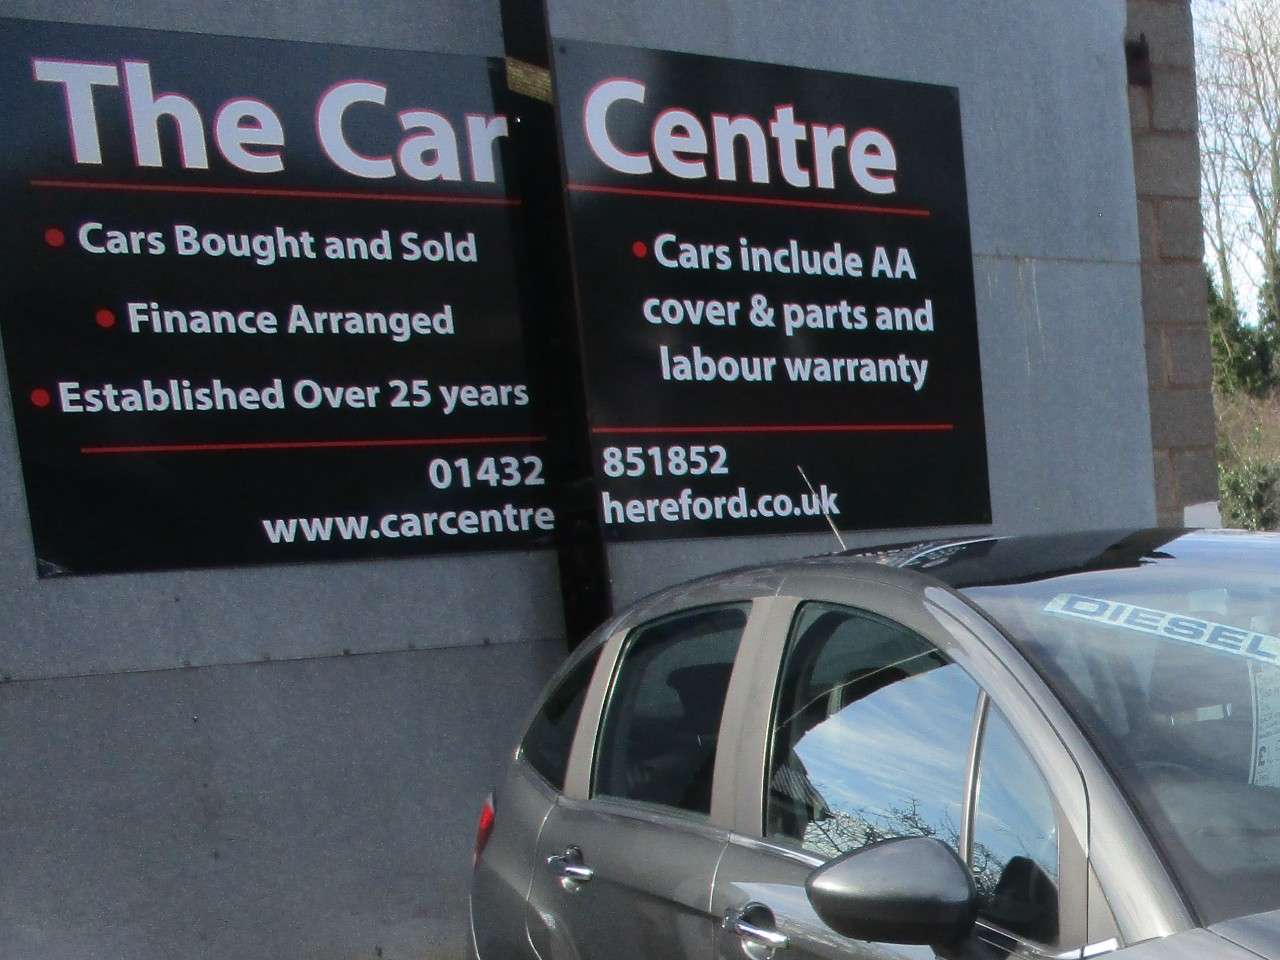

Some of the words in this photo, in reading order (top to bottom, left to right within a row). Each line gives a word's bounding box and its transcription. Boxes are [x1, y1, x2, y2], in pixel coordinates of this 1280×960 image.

[32, 57, 285, 174] The
[315, 79, 509, 183] Car
[583, 76, 898, 195] Centre
[78, 222, 165, 256] Cars
[174, 224, 316, 267] Bought
[325, 231, 392, 261] and
[402, 232, 479, 263] Sold
[653, 233, 730, 270] Cars
[739, 238, 863, 279] include
[870, 246, 917, 280] AA
[127, 302, 278, 335] Finance
[288, 304, 456, 342] Arranged
[643, 296, 740, 326] cover
[749, 293, 776, 329] &
[784, 299, 867, 337] parts
[876, 299, 934, 333] and
[659, 345, 776, 384] labour
[784, 354, 929, 391] warranty
[57, 379, 286, 414] Established
[294, 379, 380, 410] Over
[389, 379, 431, 409] 25
[439, 383, 531, 416] years
[428, 455, 546, 490] 01432
[602, 444, 729, 479] 851852
[262, 502, 556, 545] www.carcentre
[602, 485, 840, 525] hereford.co.uk
[1060, 595, 1280, 660] DIESEL
